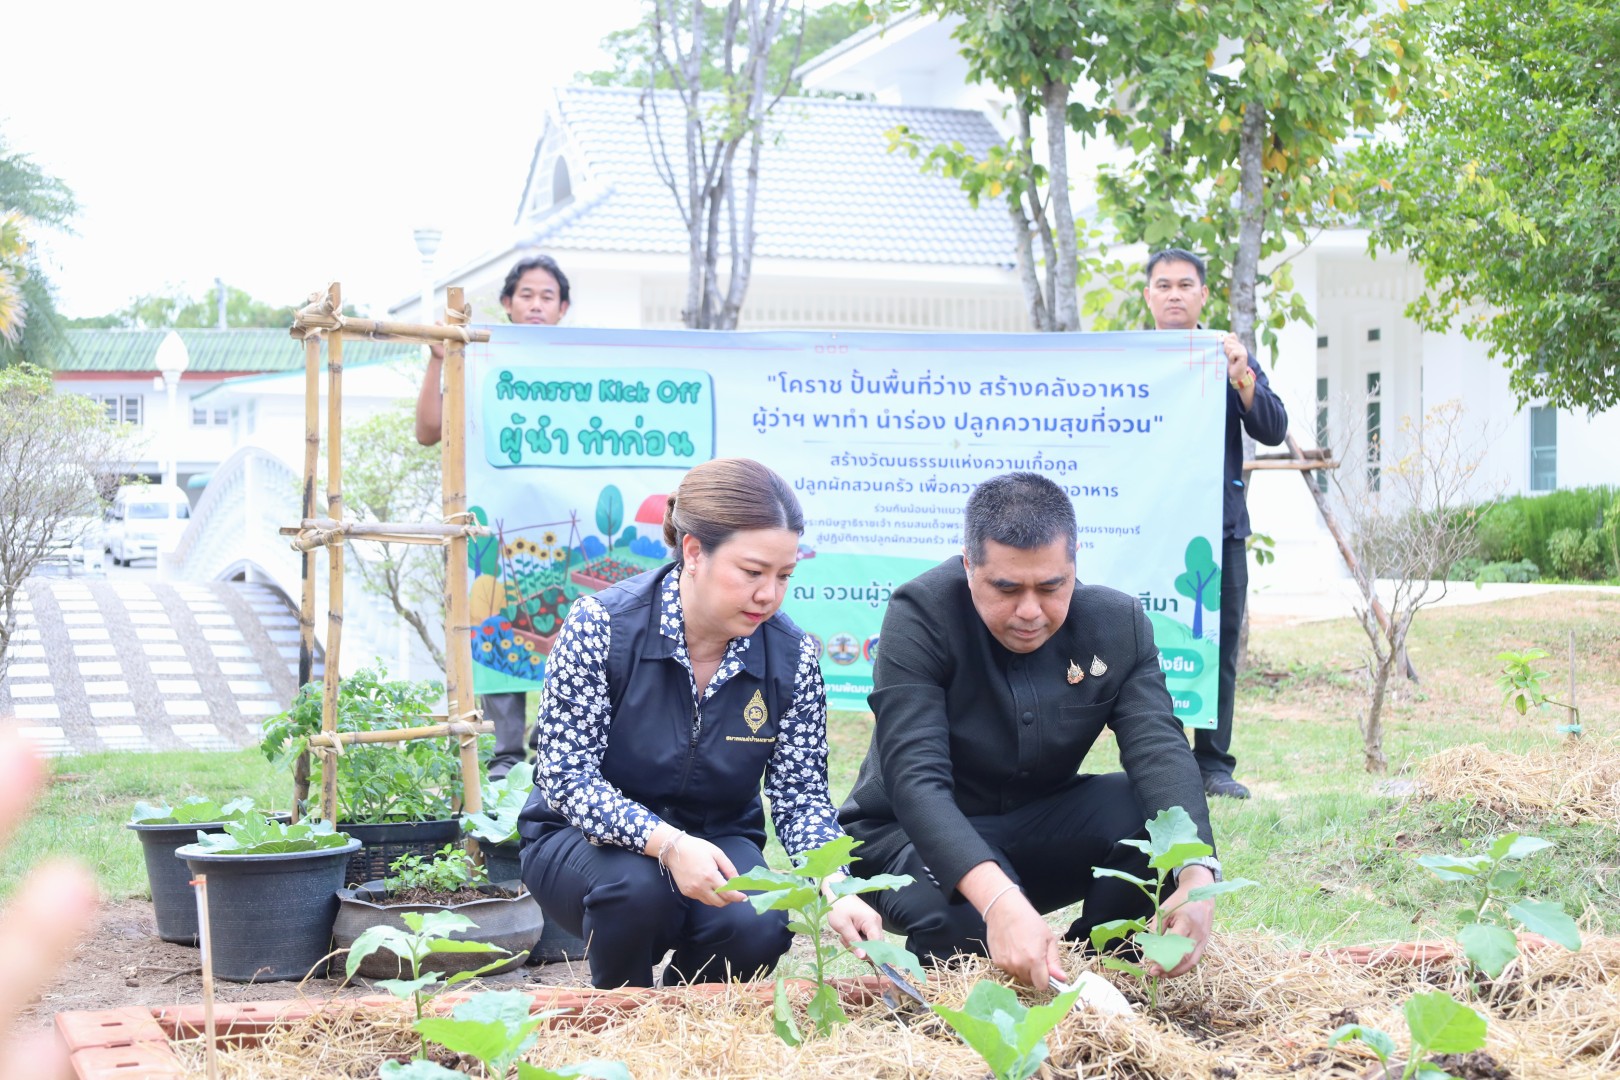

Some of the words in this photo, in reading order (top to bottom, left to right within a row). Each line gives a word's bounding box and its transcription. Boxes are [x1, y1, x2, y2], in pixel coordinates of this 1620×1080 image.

[496, 370, 592, 402] กิจกรรม
[598, 379, 650, 403] Kick
[657, 380, 702, 404] Off
[768, 371, 843, 395] "โคราช
[850, 368, 972, 396] ปั้นพื้นที่ว่าง
[979, 375, 1150, 399] สร้างคลังอาหาร
[499, 412, 569, 464] ผู้นำ
[578, 415, 695, 457] ทำก่อน
[753, 406, 805, 434] ผู้ว่าฯ
[813, 408, 868, 430] พาทำ
[876, 409, 947, 431] นำร่อง
[954, 406, 1164, 439] ปลูกความสุขที่จวน"
[830, 451, 1078, 475] สร้างวัฒนธรรมแห่งความเกื้อกูล
[795, 477, 913, 496] ปลูกผักสวนครัว
[793, 586, 815, 600] ณ
